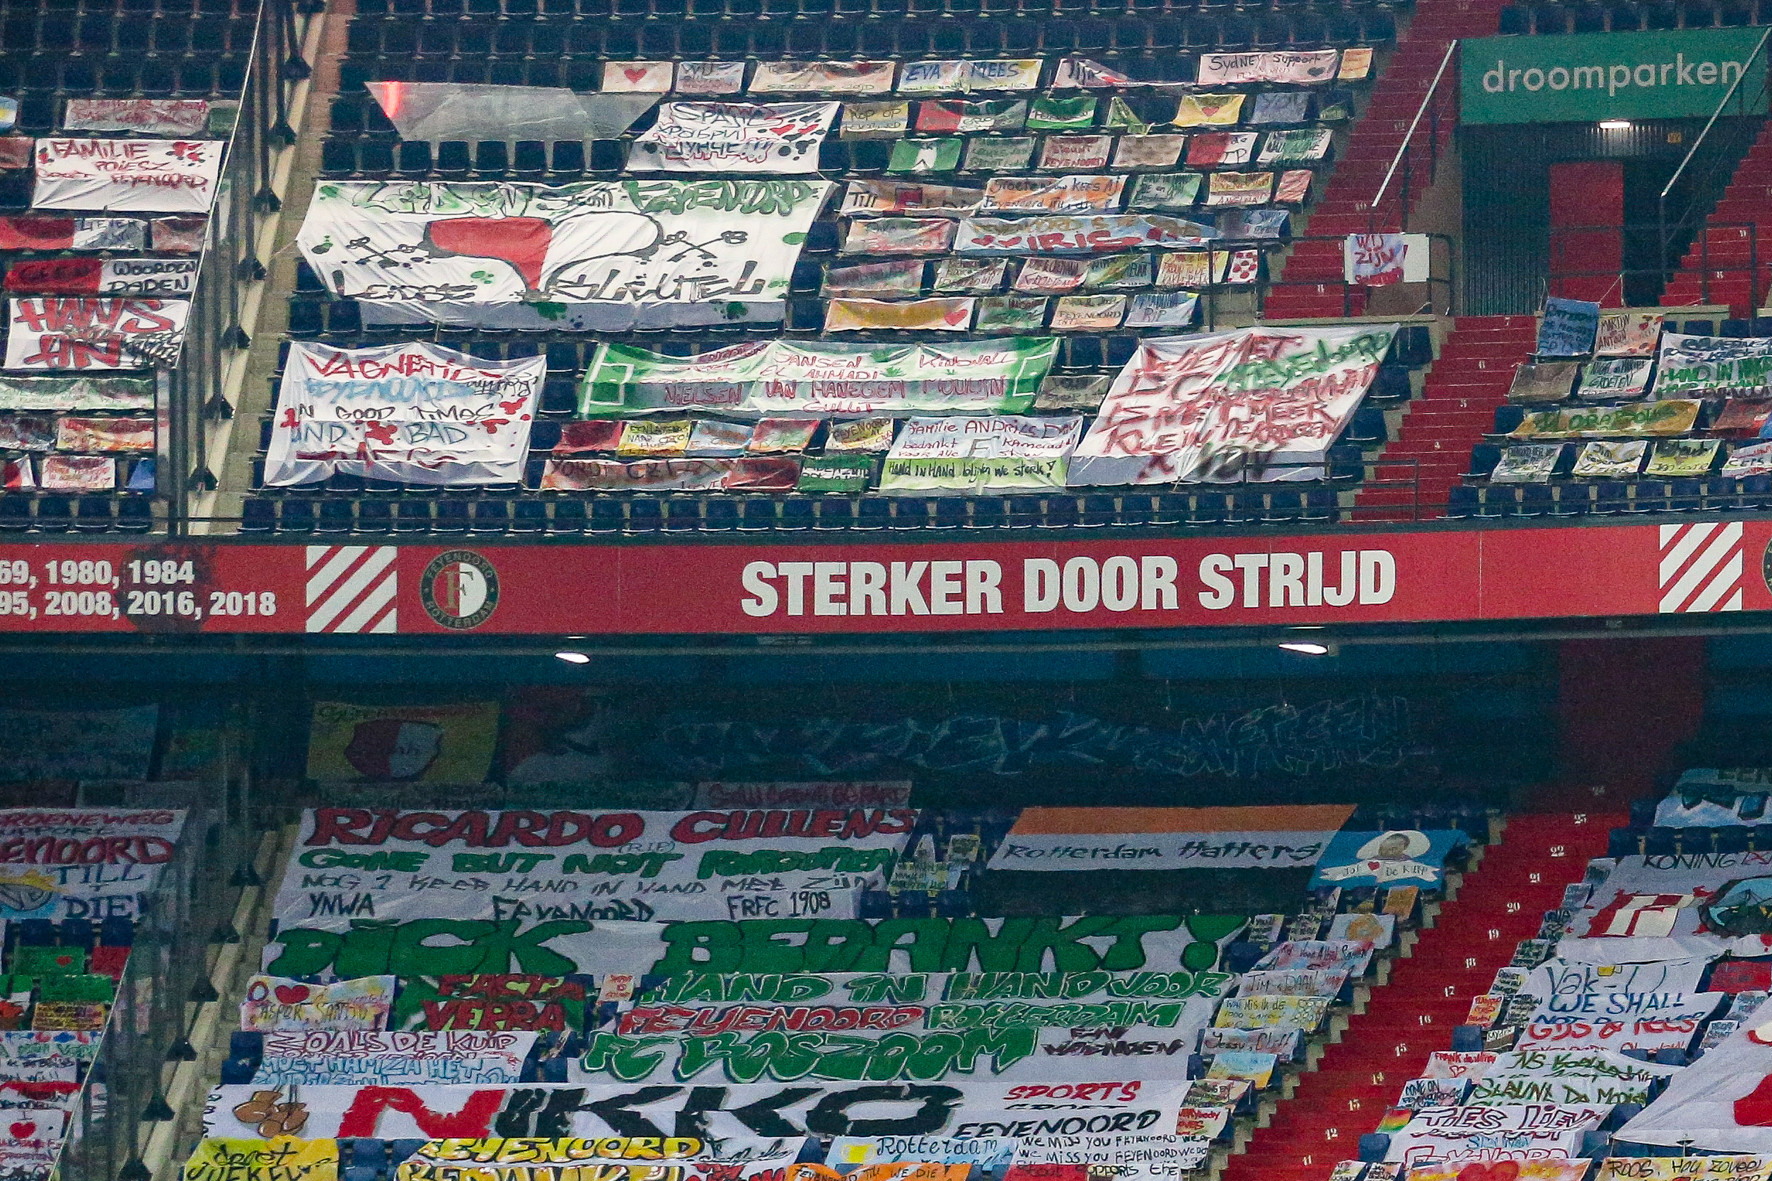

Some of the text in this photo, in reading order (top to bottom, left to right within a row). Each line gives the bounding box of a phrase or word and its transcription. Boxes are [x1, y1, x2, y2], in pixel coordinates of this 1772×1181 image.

[1483, 52, 1745, 97] droomparken
[108, 278, 190, 292] DADEN
[46, 560, 120, 590] 1980,
[128, 560, 195, 584] 1984
[741, 549, 1396, 616] STERKER DOOR STRIJD
[45, 592, 120, 620] 2008,
[127, 591, 202, 620] 2016,
[210, 591, 277, 616] 2018
[302, 807, 646, 847] RICARDO
[452, 850, 556, 876] BUT
[1002, 840, 1324, 862] Rotterdam Hatters
[308, 890, 831, 918] YNWA FRFC 1908
[267, 917, 594, 978] DICK
[618, 1004, 926, 1036] FEYENOORD
[1002, 1081, 1142, 1102] SPORTS
[952, 1110, 1162, 1138] FEYENOORD
